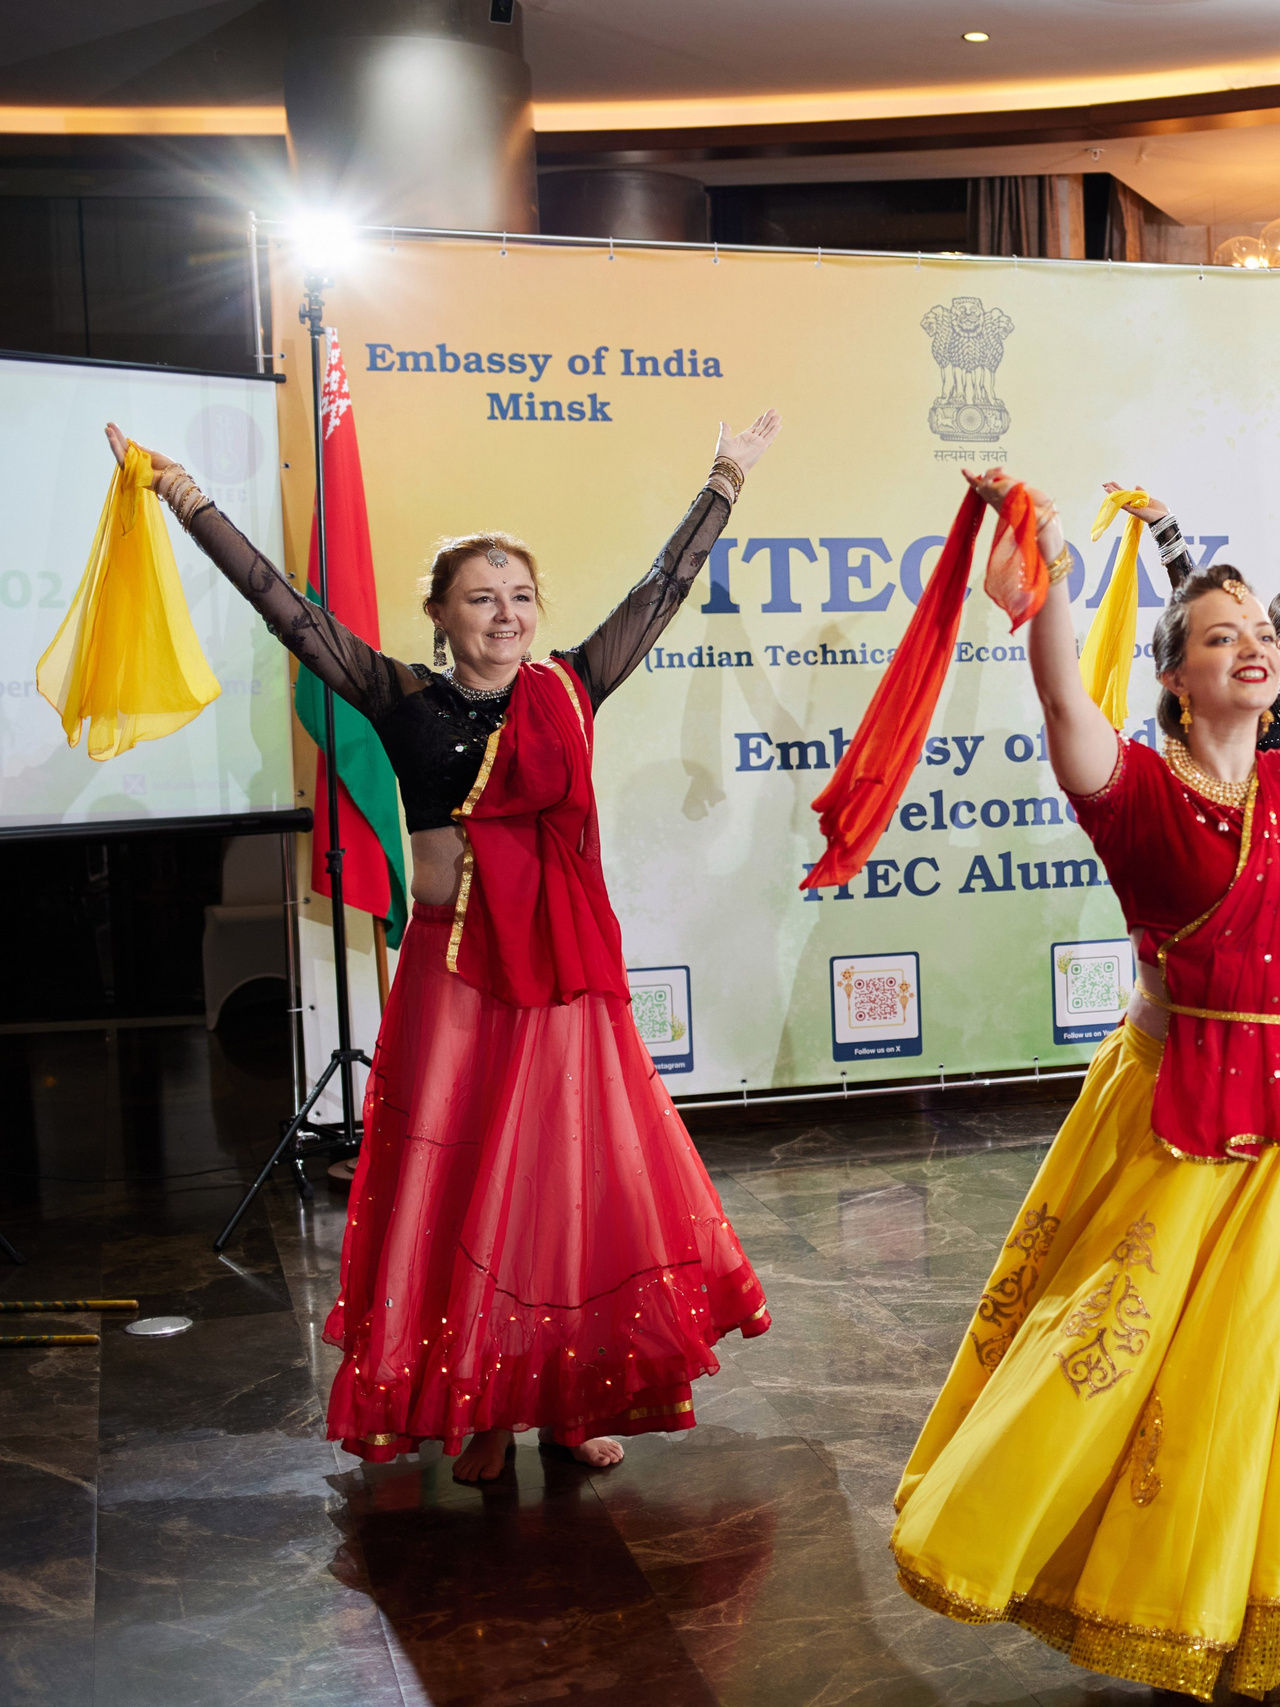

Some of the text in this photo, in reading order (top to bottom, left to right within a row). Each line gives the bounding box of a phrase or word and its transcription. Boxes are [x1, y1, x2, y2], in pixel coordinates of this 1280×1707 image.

[365, 343, 724, 382] Embassy of India
[486, 392, 613, 422] Minsk
[933, 446, 1008, 463] सत्यमेव जयते
[645, 645, 754, 673] (Indian
[764, 643, 899, 667] Technica
[734, 728, 984, 777] Embsy
[958, 851, 1112, 894] Alum
[854, 1048, 875, 1056] Follow
[895, 1045, 902, 1053] X
[1063, 1032, 1083, 1040] Follow
